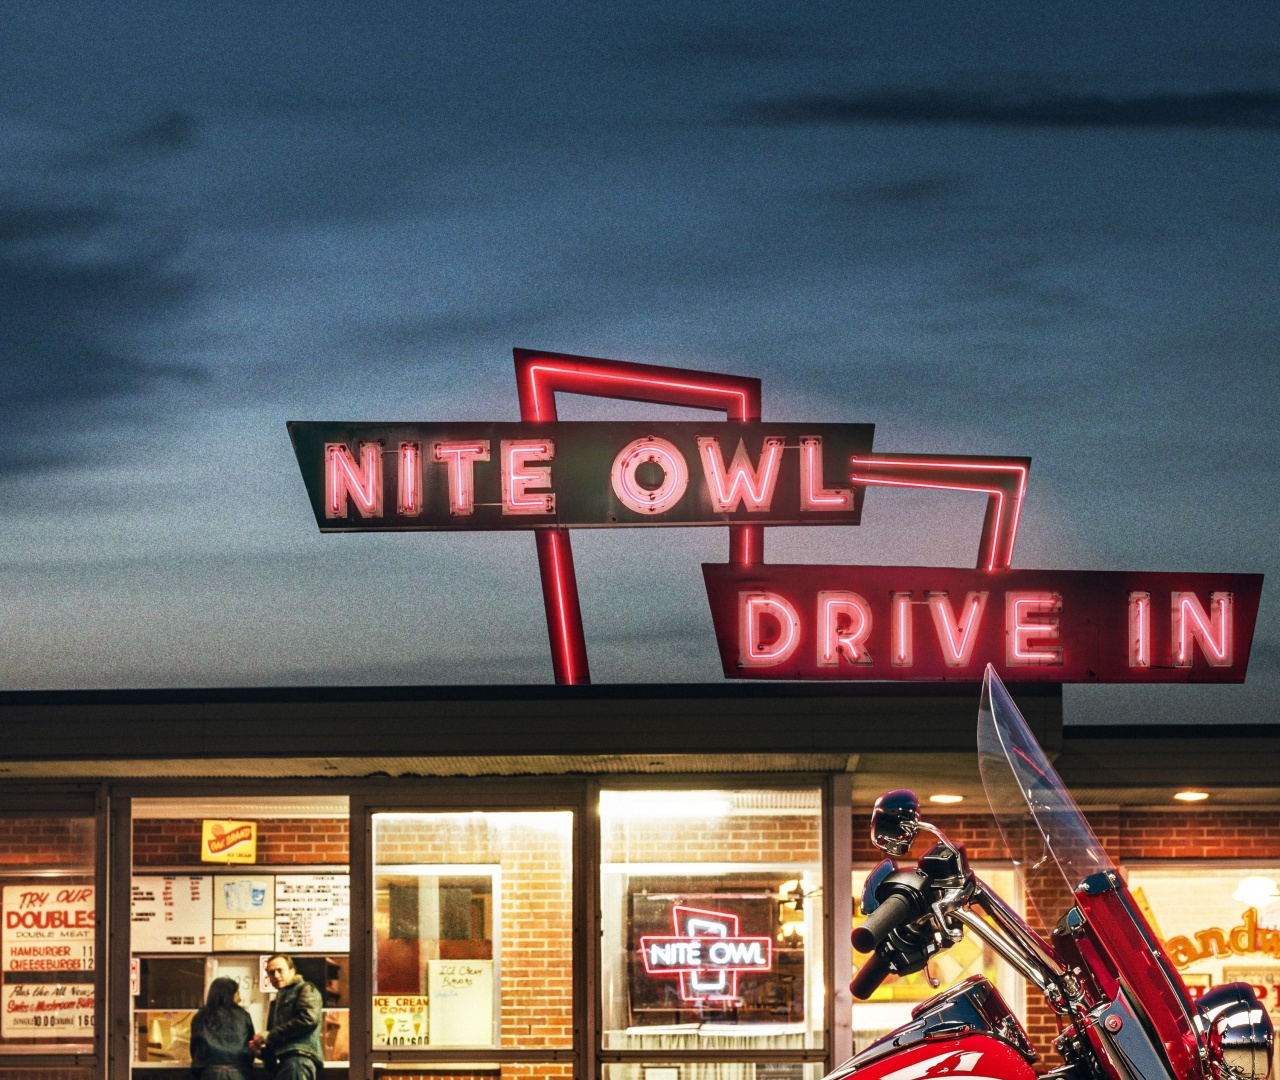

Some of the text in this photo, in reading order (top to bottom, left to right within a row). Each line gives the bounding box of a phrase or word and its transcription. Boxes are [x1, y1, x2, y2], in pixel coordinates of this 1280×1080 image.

[324, 436, 855, 519] NITE OWL
[738, 591, 1233, 667] DRIVE IN
[19, 888, 93, 910] TRY OUR
[6, 910, 95, 930] DOUBLES
[16, 930, 91, 939] DOUBLE MEAT
[10, 945, 72, 958] HAMBURGER
[651, 942, 766, 964] NITE OWL
[439, 965, 456, 976] ICE
[374, 997, 390, 1007] ICE
[379, 1006, 424, 1015] CONES
